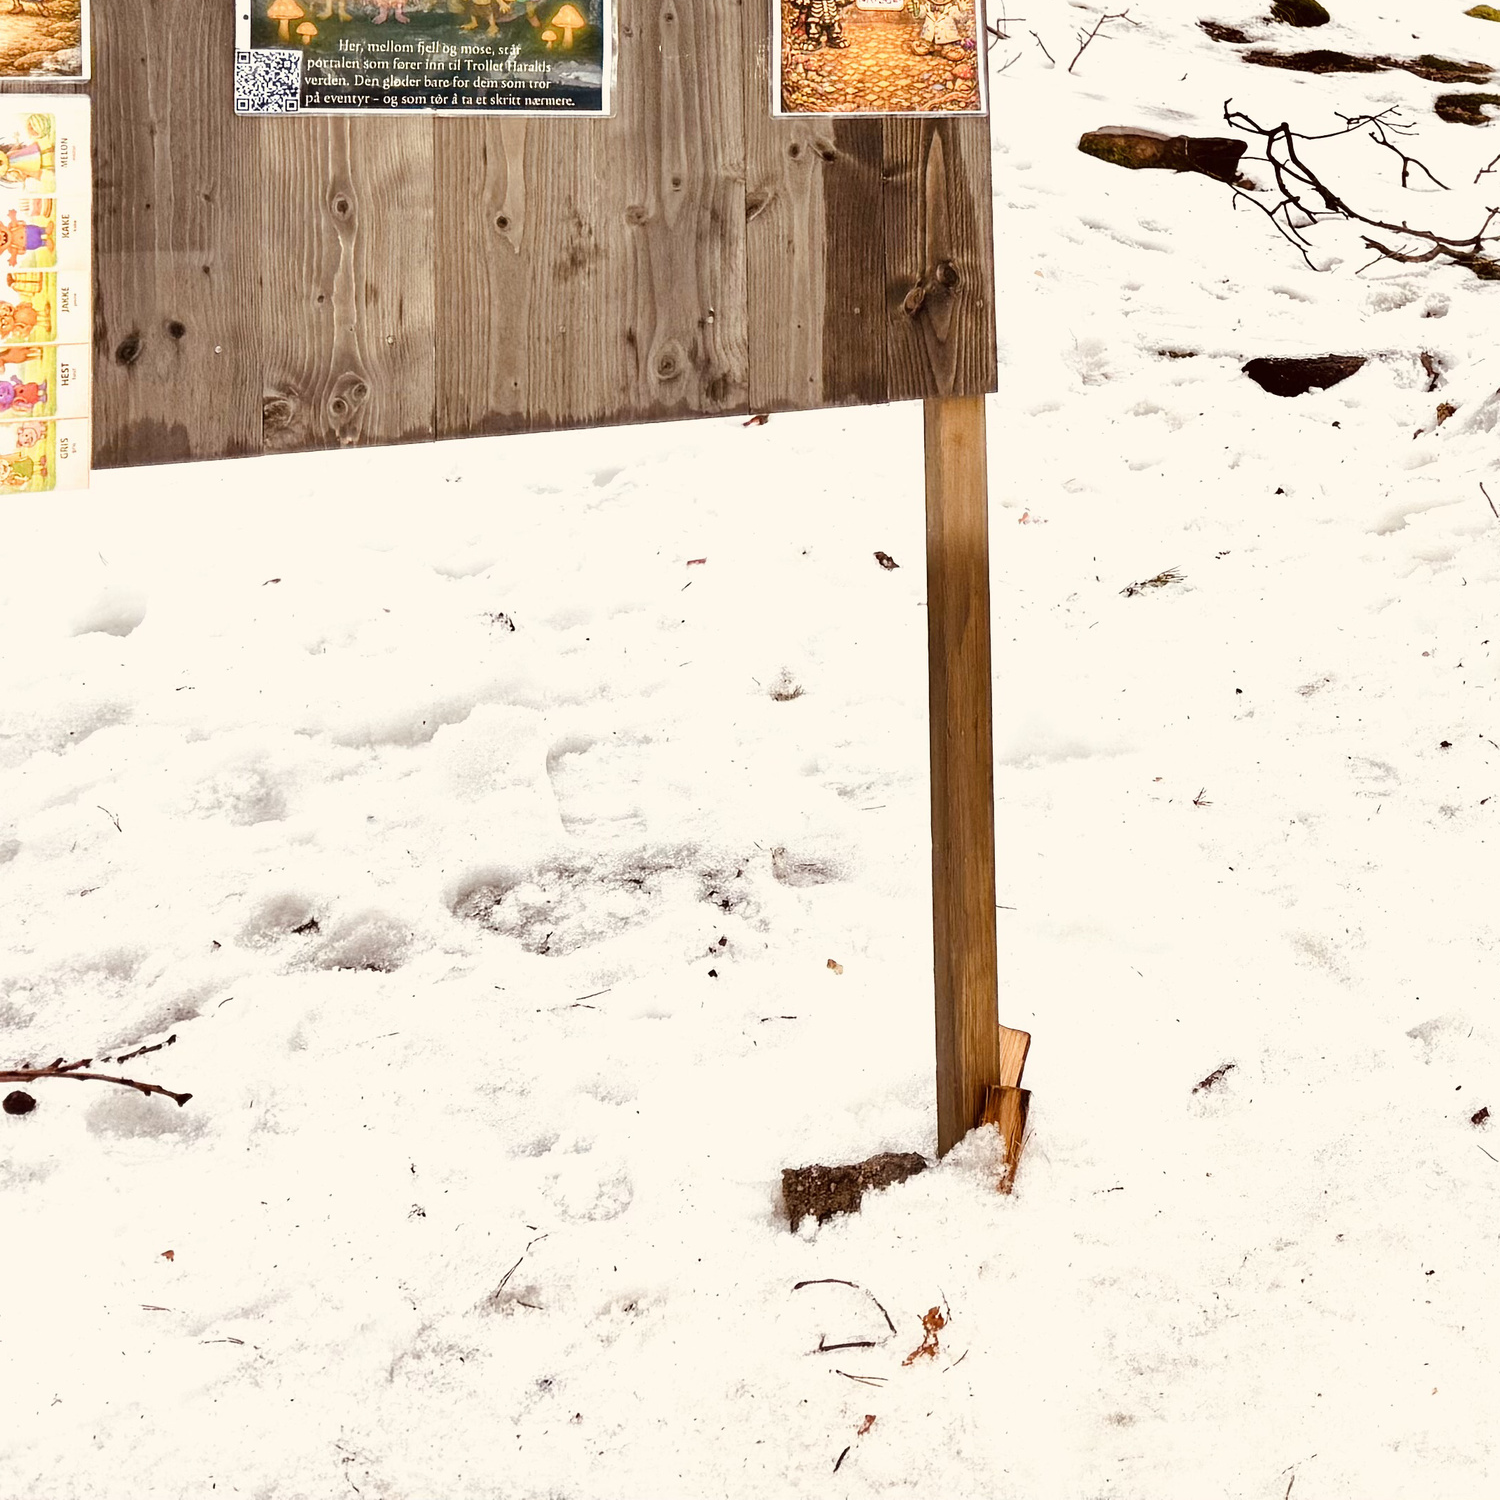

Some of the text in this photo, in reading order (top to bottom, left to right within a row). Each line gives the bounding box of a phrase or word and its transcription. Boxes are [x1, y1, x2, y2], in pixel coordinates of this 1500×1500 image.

[339, 39, 364, 54] Her,
[367, 40, 414, 53] mellom
[417, 39, 439, 55] fjell
[443, 44, 457, 57] og
[460, 46, 495, 56] mose,
[307, 57, 552, 73] portalen som fører inn til Trollet Haralds
[304, 74, 552, 90] verden. Den gløder bare for dem som tror
[305, 91, 320, 107] på
[323, 94, 370, 107] eventyr
[383, 95, 399, 108] og
[401, 95, 427, 105] som
[430, 94, 448, 105] tør
[451, 93, 458, 105] å
[461, 95, 473, 105] ta
[476, 95, 488, 105] et
[490, 93, 521, 106] skritt
[525, 96, 576, 107] nærmere.
[61, 137, 69, 169] MELON
[61, 213, 70, 239] KAKE
[60, 362, 70, 387] HEST
[60, 437, 69, 460] GRIS
